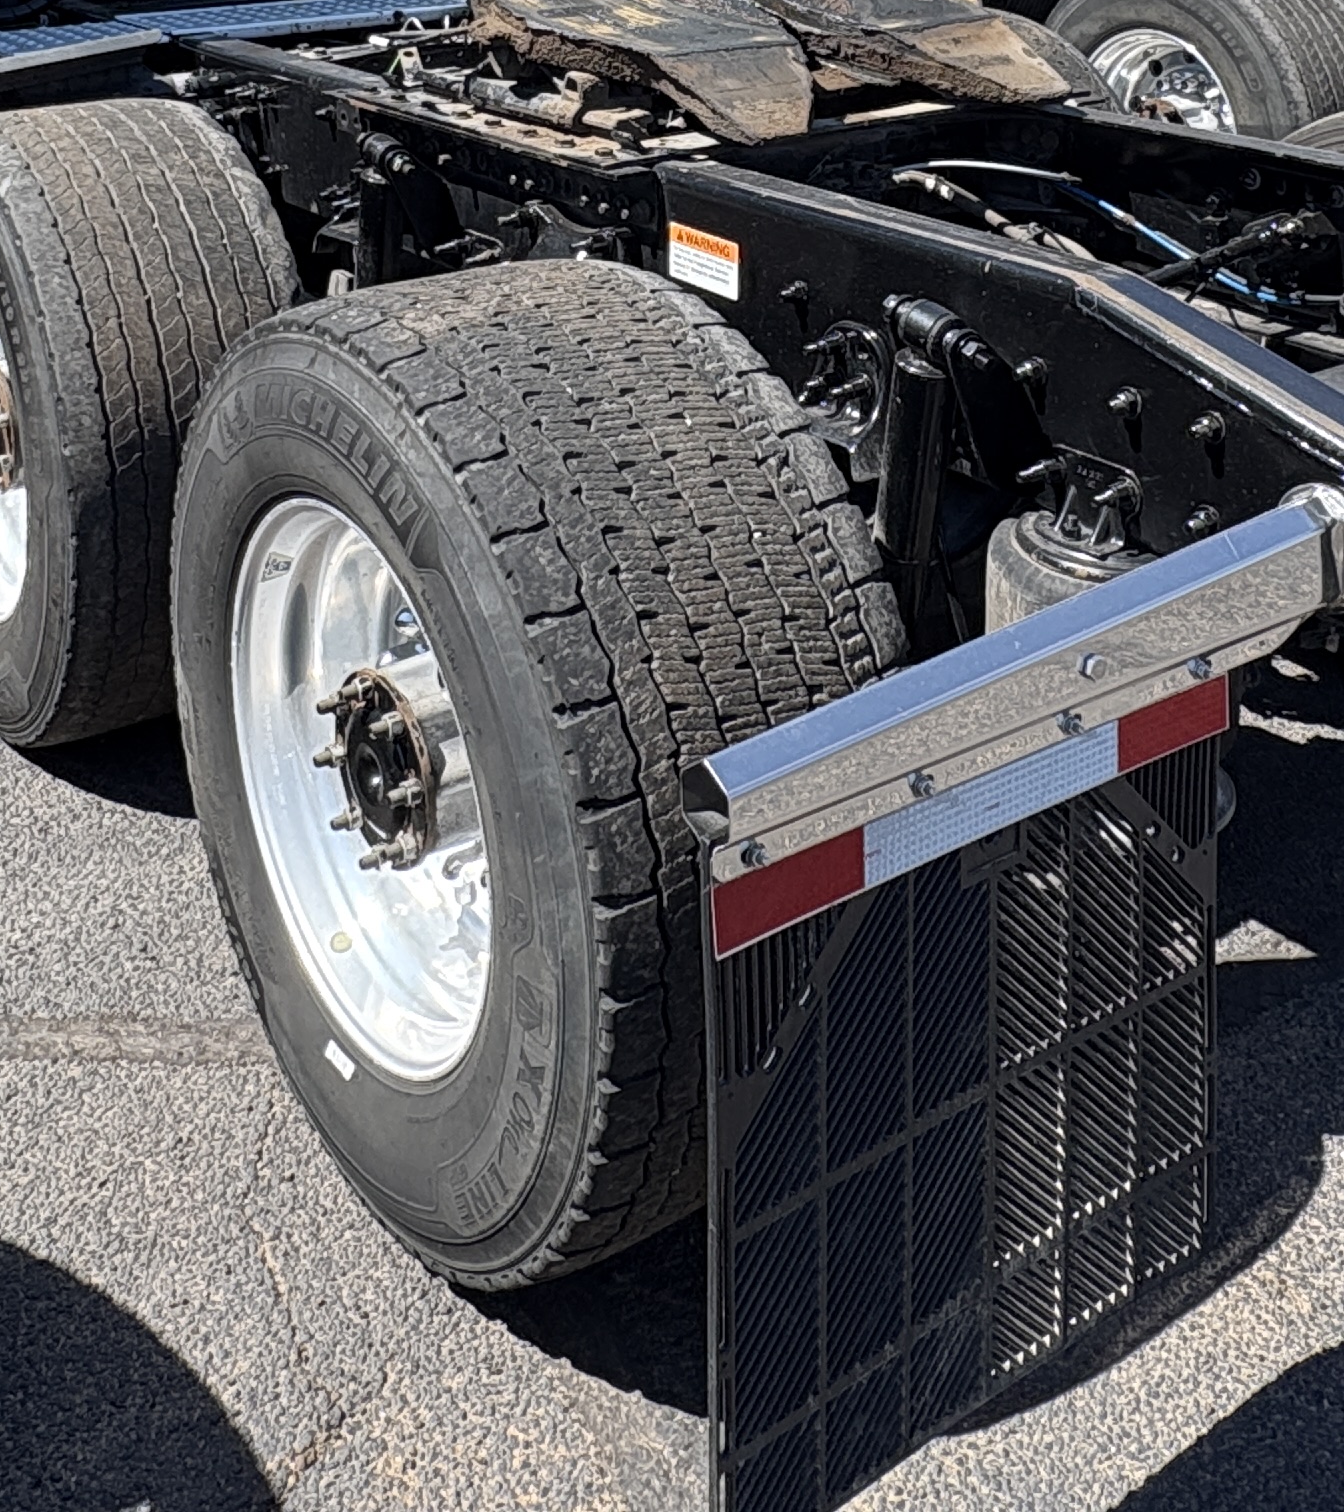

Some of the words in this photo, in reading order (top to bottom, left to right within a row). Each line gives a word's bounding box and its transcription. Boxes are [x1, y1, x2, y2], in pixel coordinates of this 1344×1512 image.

[685, 232, 730, 258] WARNING
[253, 382, 418, 527] MICHELIN
[454, 1162, 511, 1226] LINE
